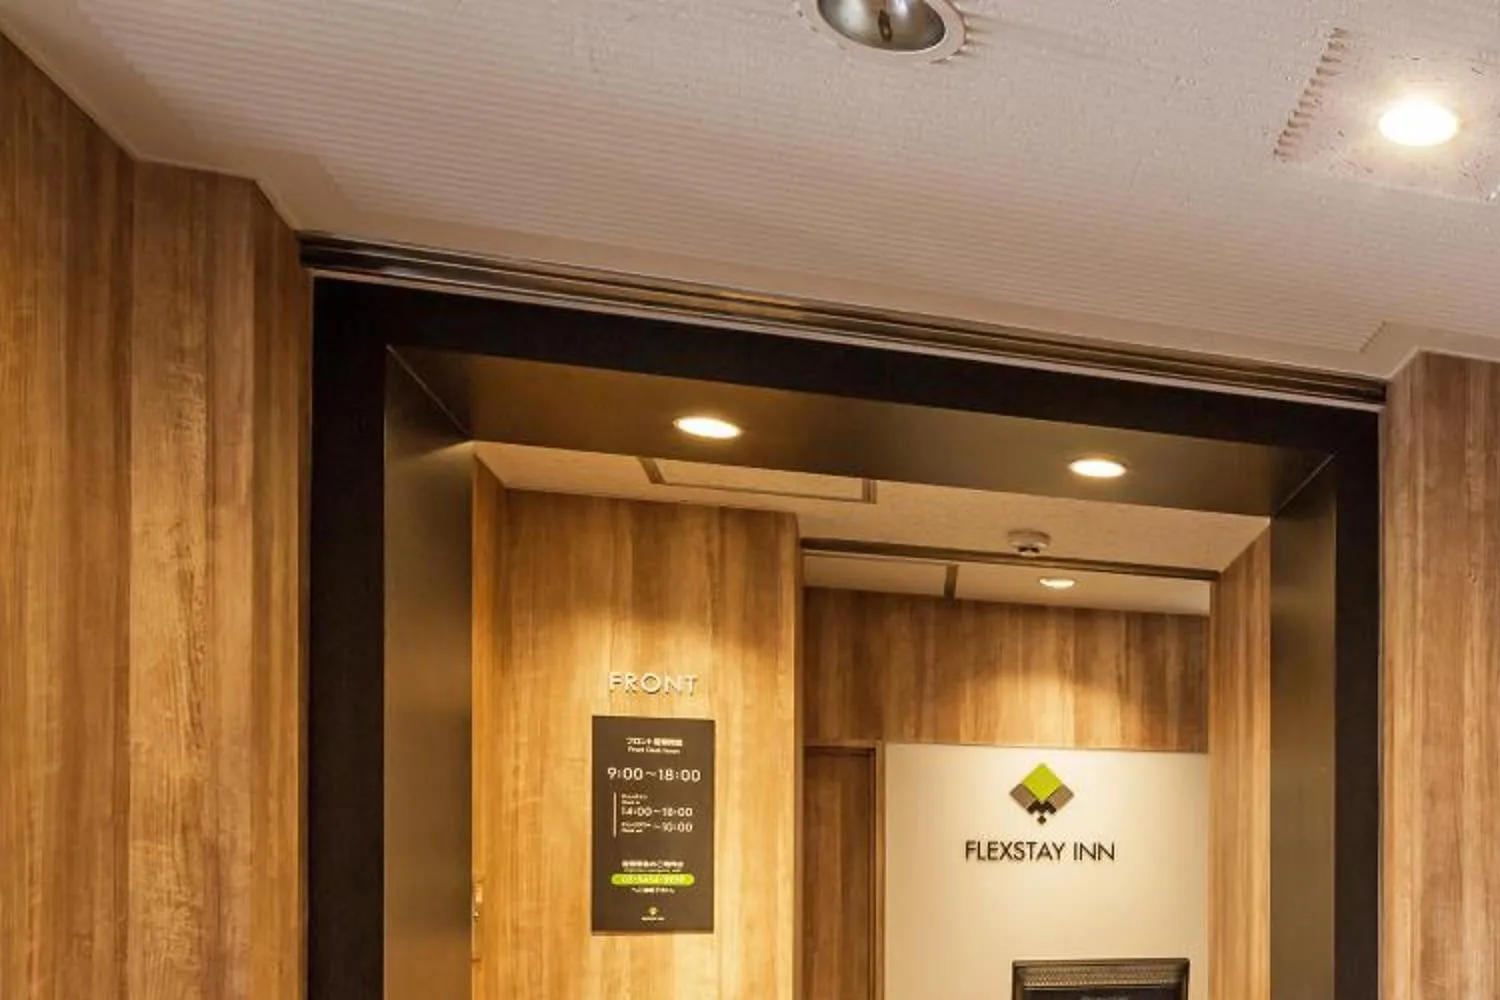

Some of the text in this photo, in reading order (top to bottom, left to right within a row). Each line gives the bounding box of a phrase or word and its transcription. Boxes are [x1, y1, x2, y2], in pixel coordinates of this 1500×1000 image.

[608, 672, 698, 694] FRONT
[965, 840, 1115, 861] FLEXSTAY INN
